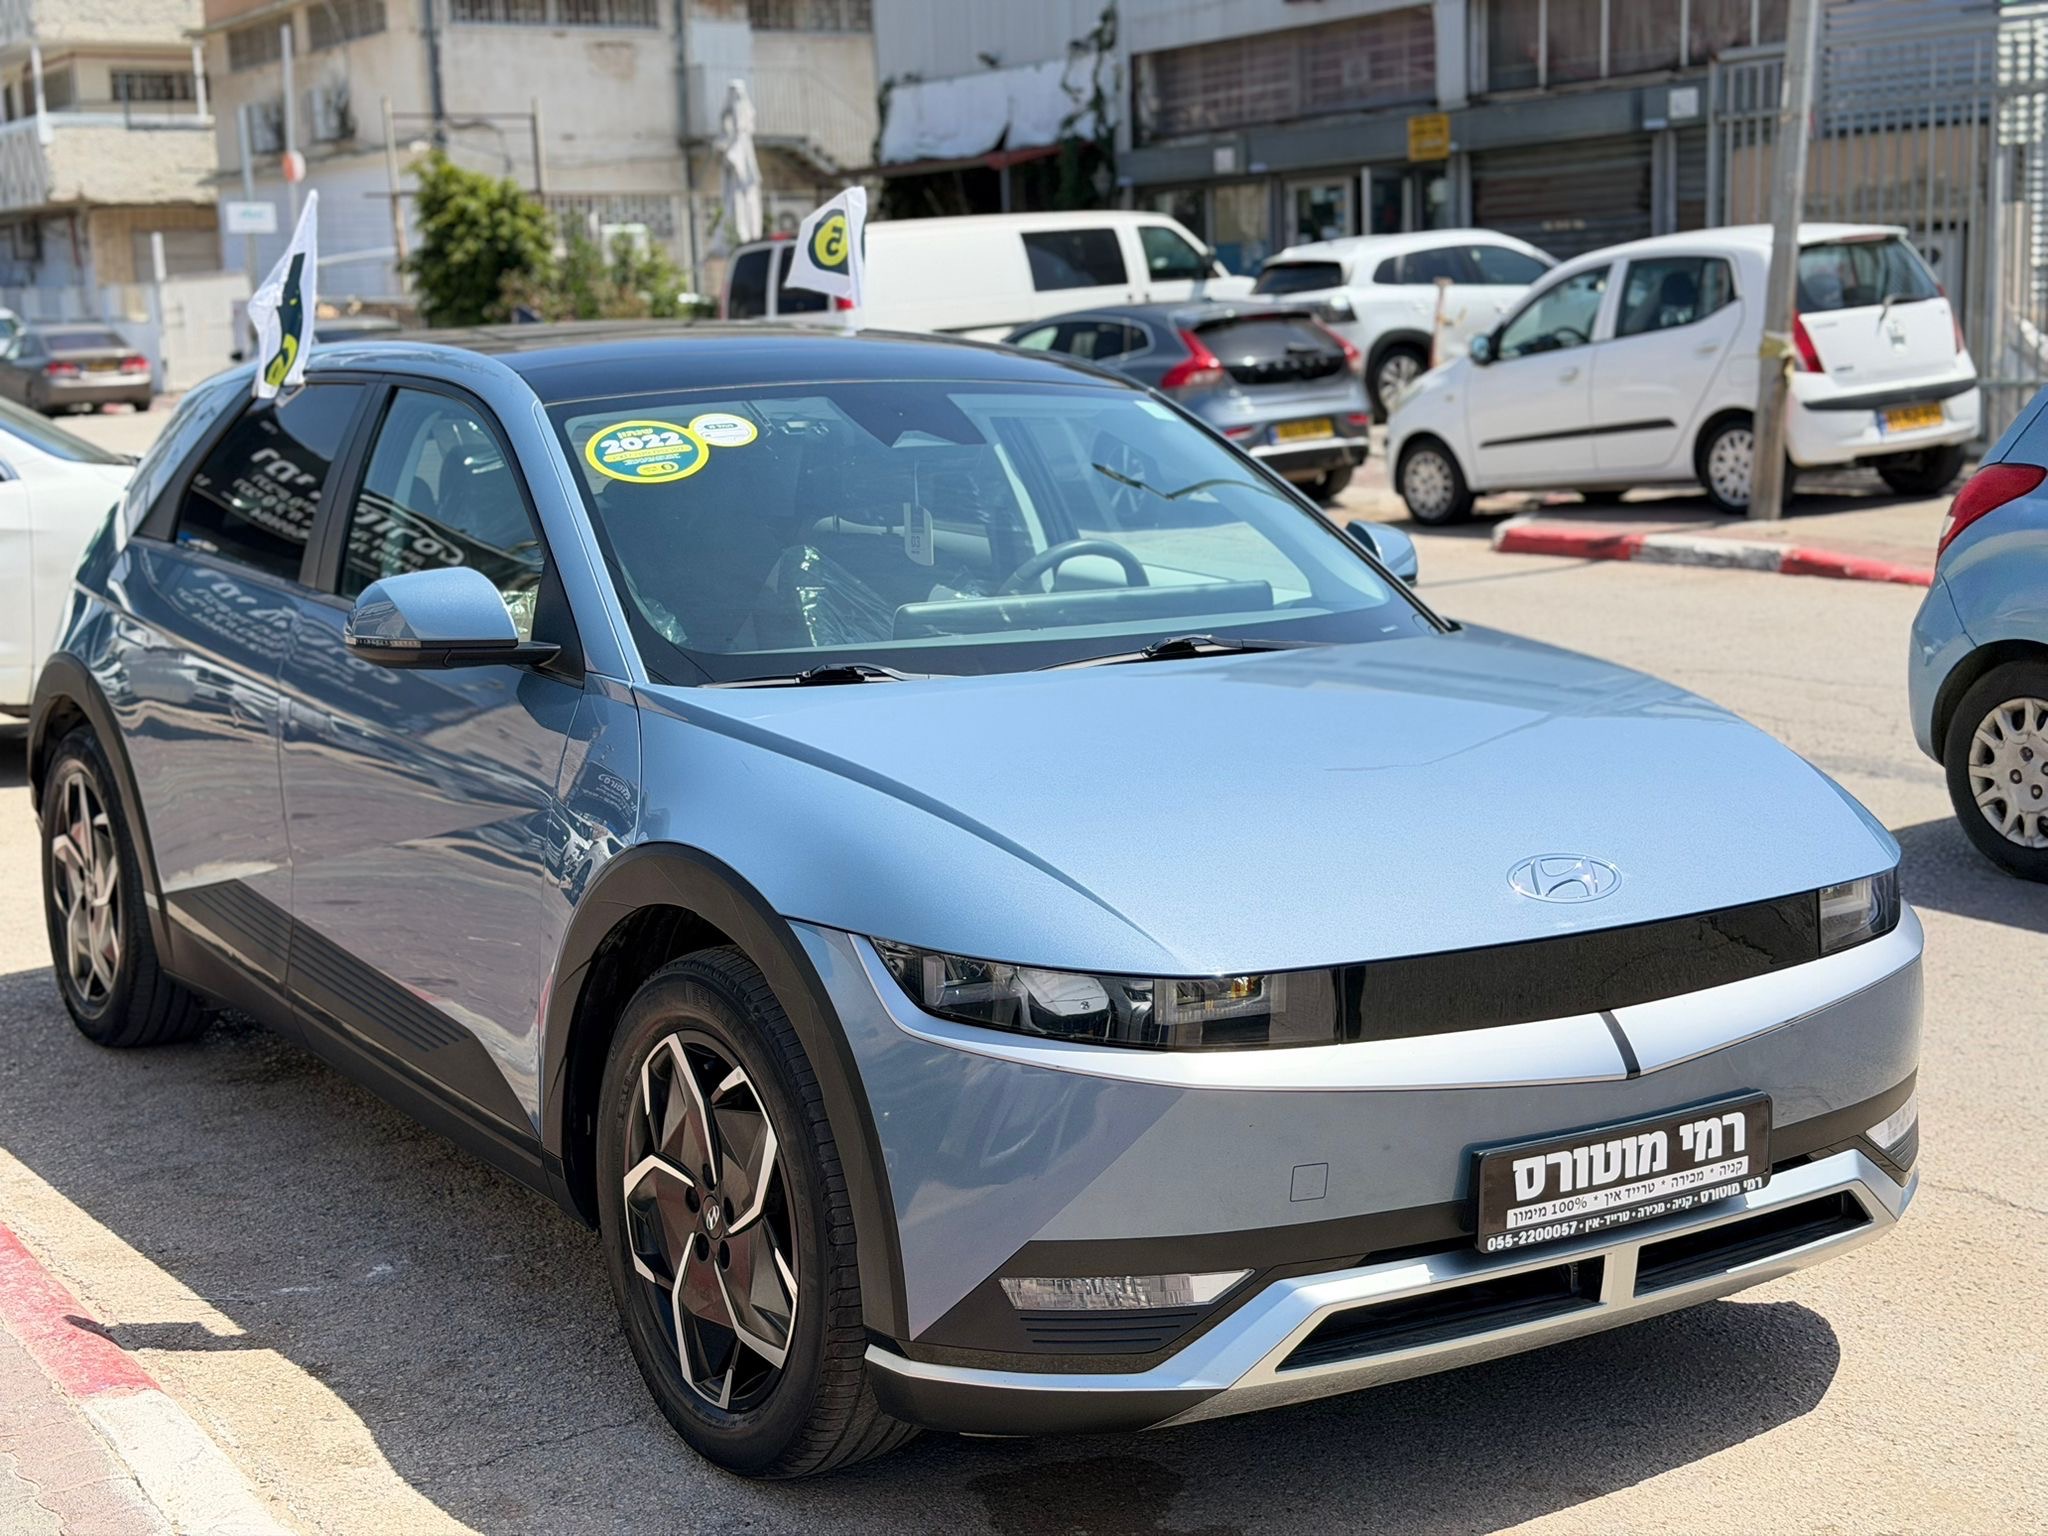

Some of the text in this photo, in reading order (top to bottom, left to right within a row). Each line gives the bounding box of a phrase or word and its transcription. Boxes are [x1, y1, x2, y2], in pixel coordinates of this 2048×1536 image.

[600, 431, 684, 455] 2022
[1512, 1111, 1745, 1202] רמי מוטורס
[1513, 1160, 1744, 1226] קניה מכירה טרייד אין 100% מימון
[1700, 1182, 1741, 1204] מוטורס
[1742, 1176, 1763, 1191] רמי
[1637, 1202, 1666, 1219] מכירה
[1672, 1195, 1694, 1210] קניה
[1487, 1220, 1578, 1252] 055-2200057
